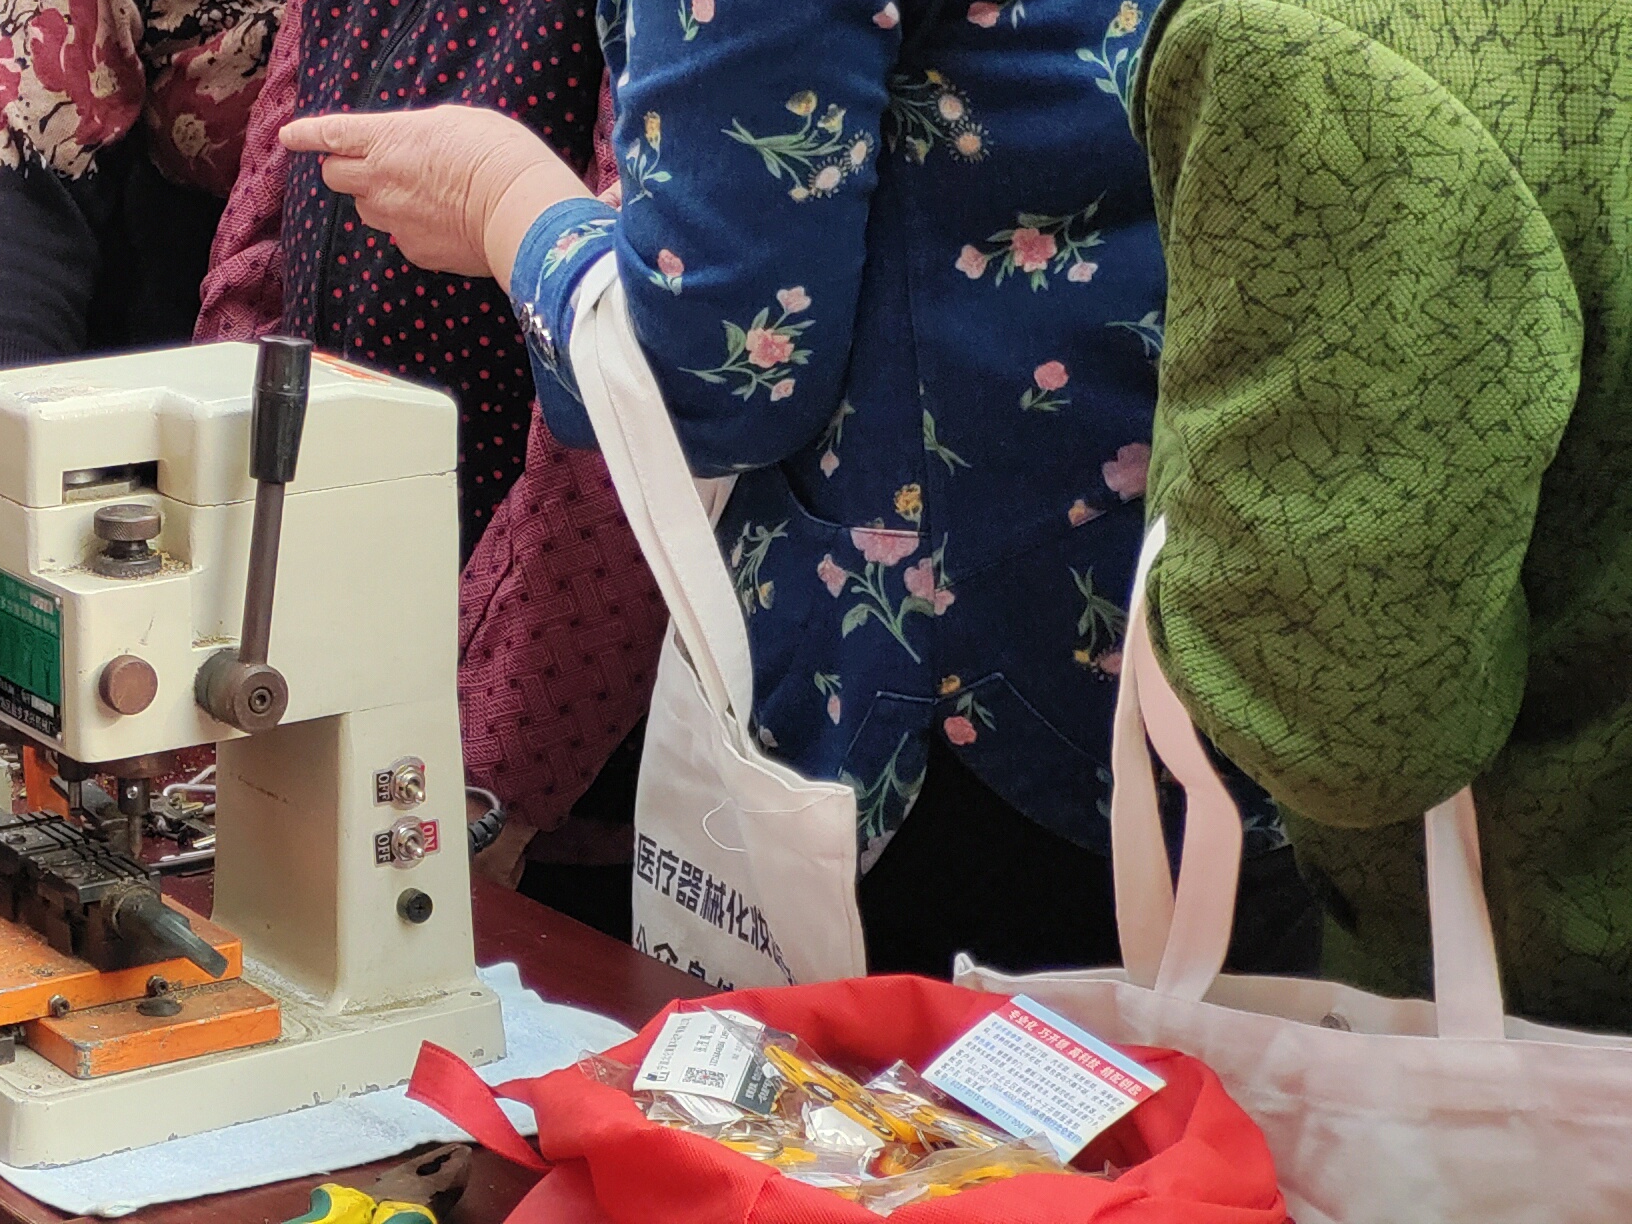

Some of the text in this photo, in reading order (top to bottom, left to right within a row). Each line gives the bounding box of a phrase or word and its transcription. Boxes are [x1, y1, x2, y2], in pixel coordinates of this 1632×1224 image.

[378, 772, 390, 801] OFF
[377, 834, 391, 864] OFF
[422, 824, 435, 852] ON
